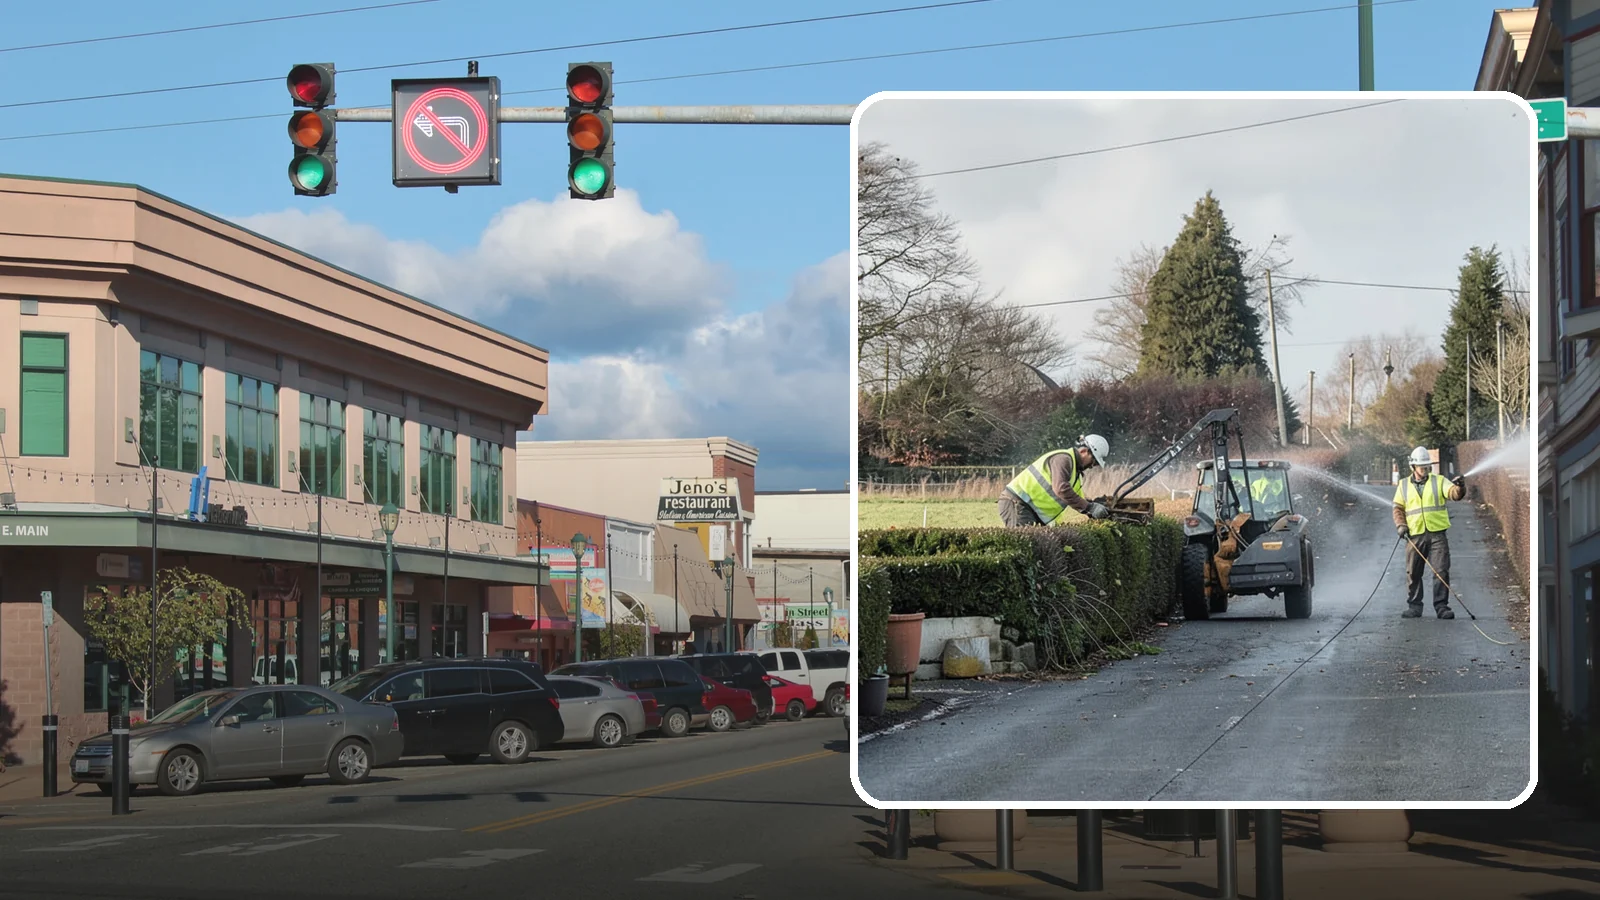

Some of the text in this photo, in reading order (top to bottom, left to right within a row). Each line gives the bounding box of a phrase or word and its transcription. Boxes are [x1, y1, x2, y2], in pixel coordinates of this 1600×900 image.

[670, 480, 727, 494] Jeno's
[665, 496, 731, 509] restaurant
[658, 510, 681, 519] Italian
[686, 510, 714, 519] American
[715, 509, 737, 519] Cuisine
[2, 525, 49, 536] E. MAIN
[797, 607, 828, 616] Street
